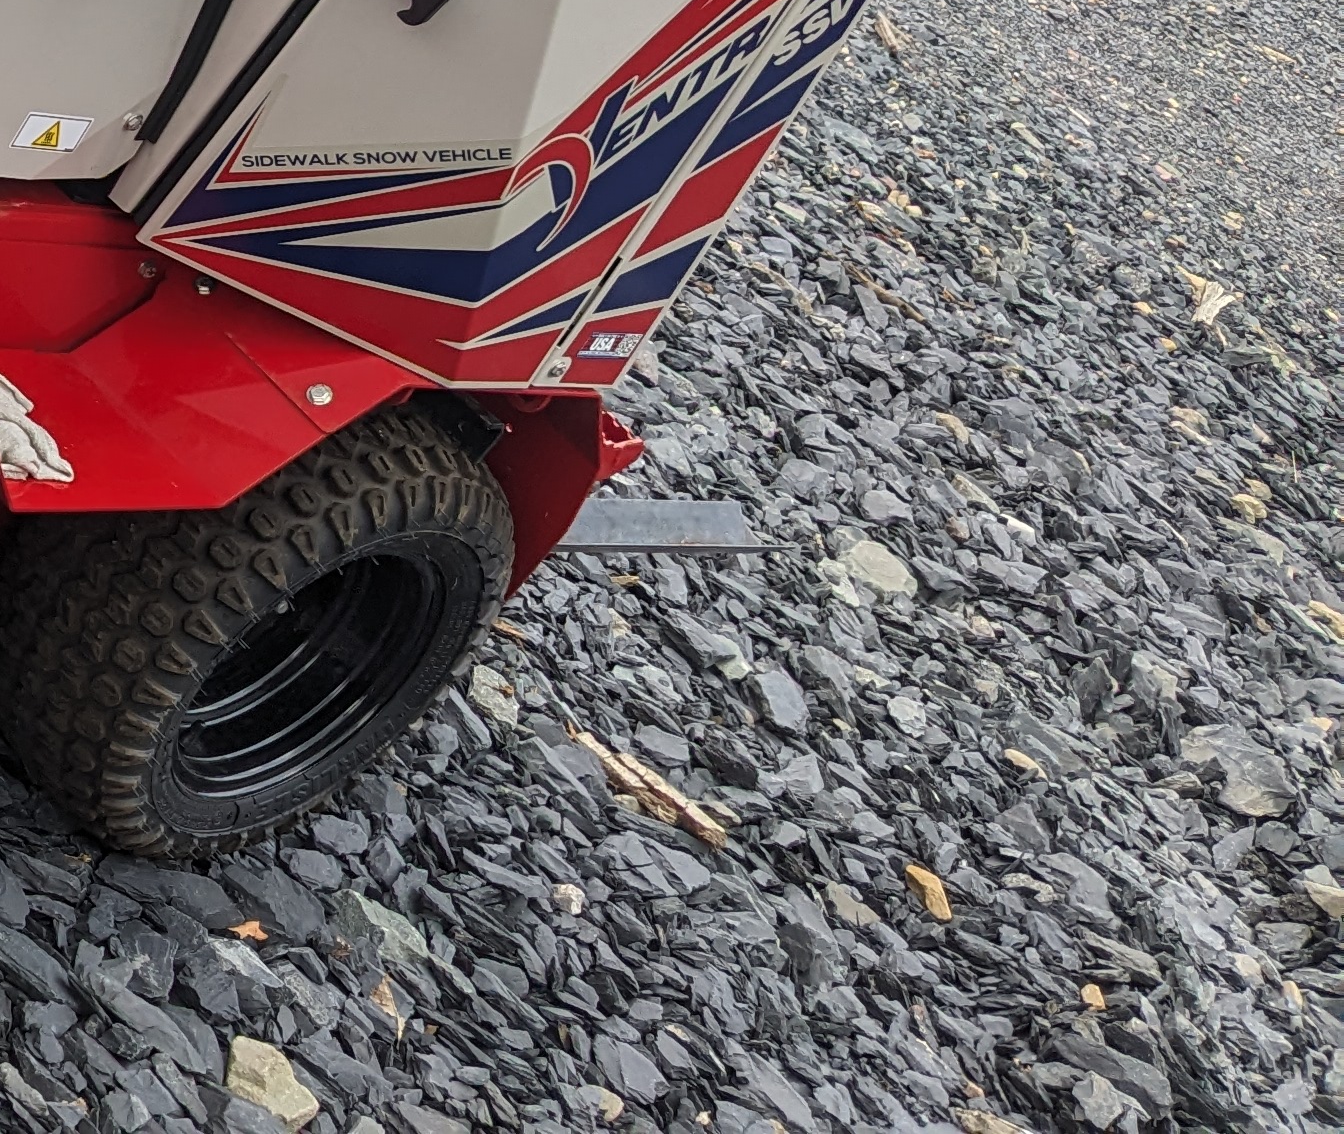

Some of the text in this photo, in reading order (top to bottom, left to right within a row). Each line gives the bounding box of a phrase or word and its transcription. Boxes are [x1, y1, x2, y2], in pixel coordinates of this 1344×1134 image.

[241, 147, 513, 168] SIDEWALK SNOW VEHICLE
[589, 337, 616, 352] USA
